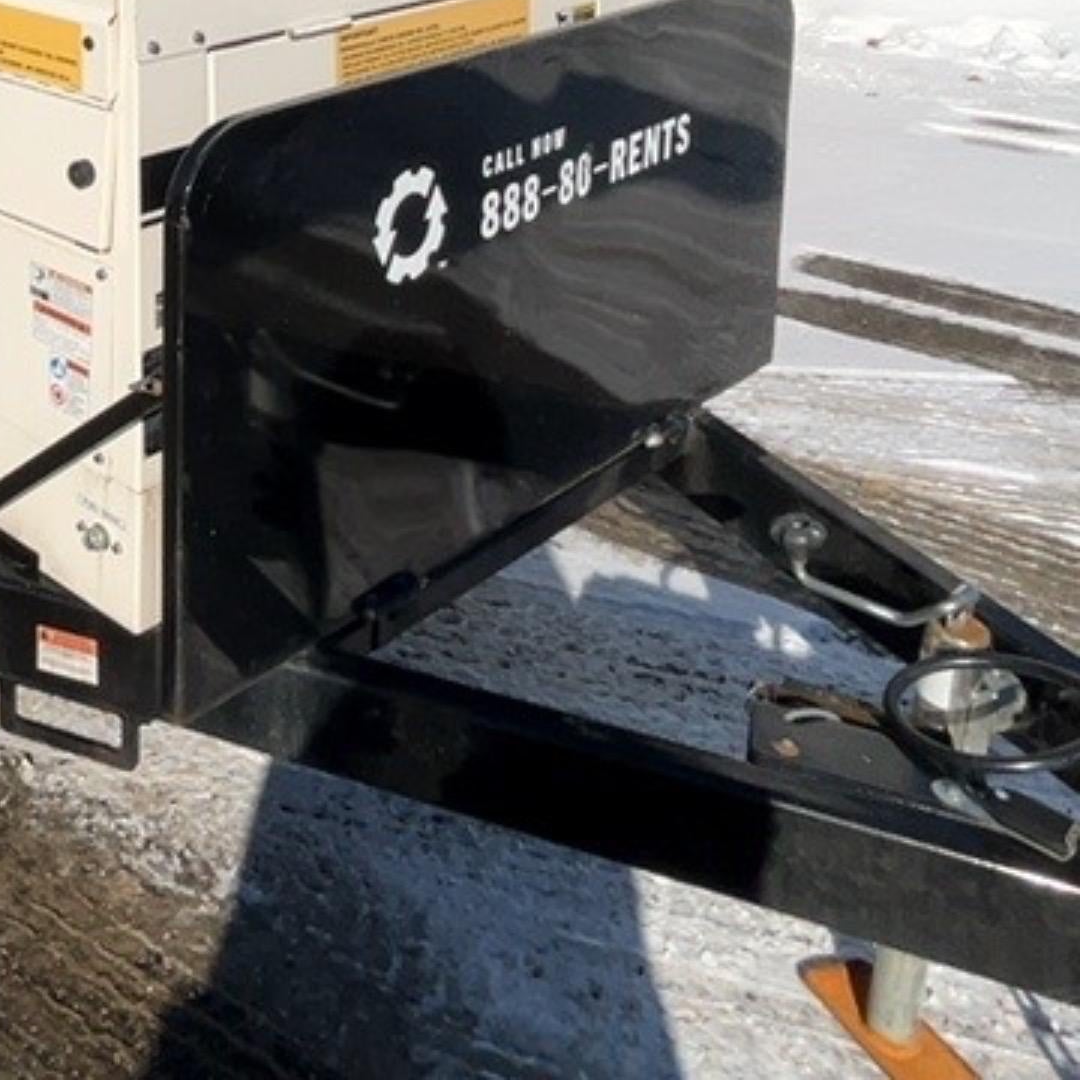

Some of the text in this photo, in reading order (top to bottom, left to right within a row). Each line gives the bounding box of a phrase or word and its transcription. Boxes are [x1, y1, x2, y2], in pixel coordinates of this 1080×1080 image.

[480, 113, 691, 240] 888-80-RENTS
[482, 125, 567, 178] CALL NOW
